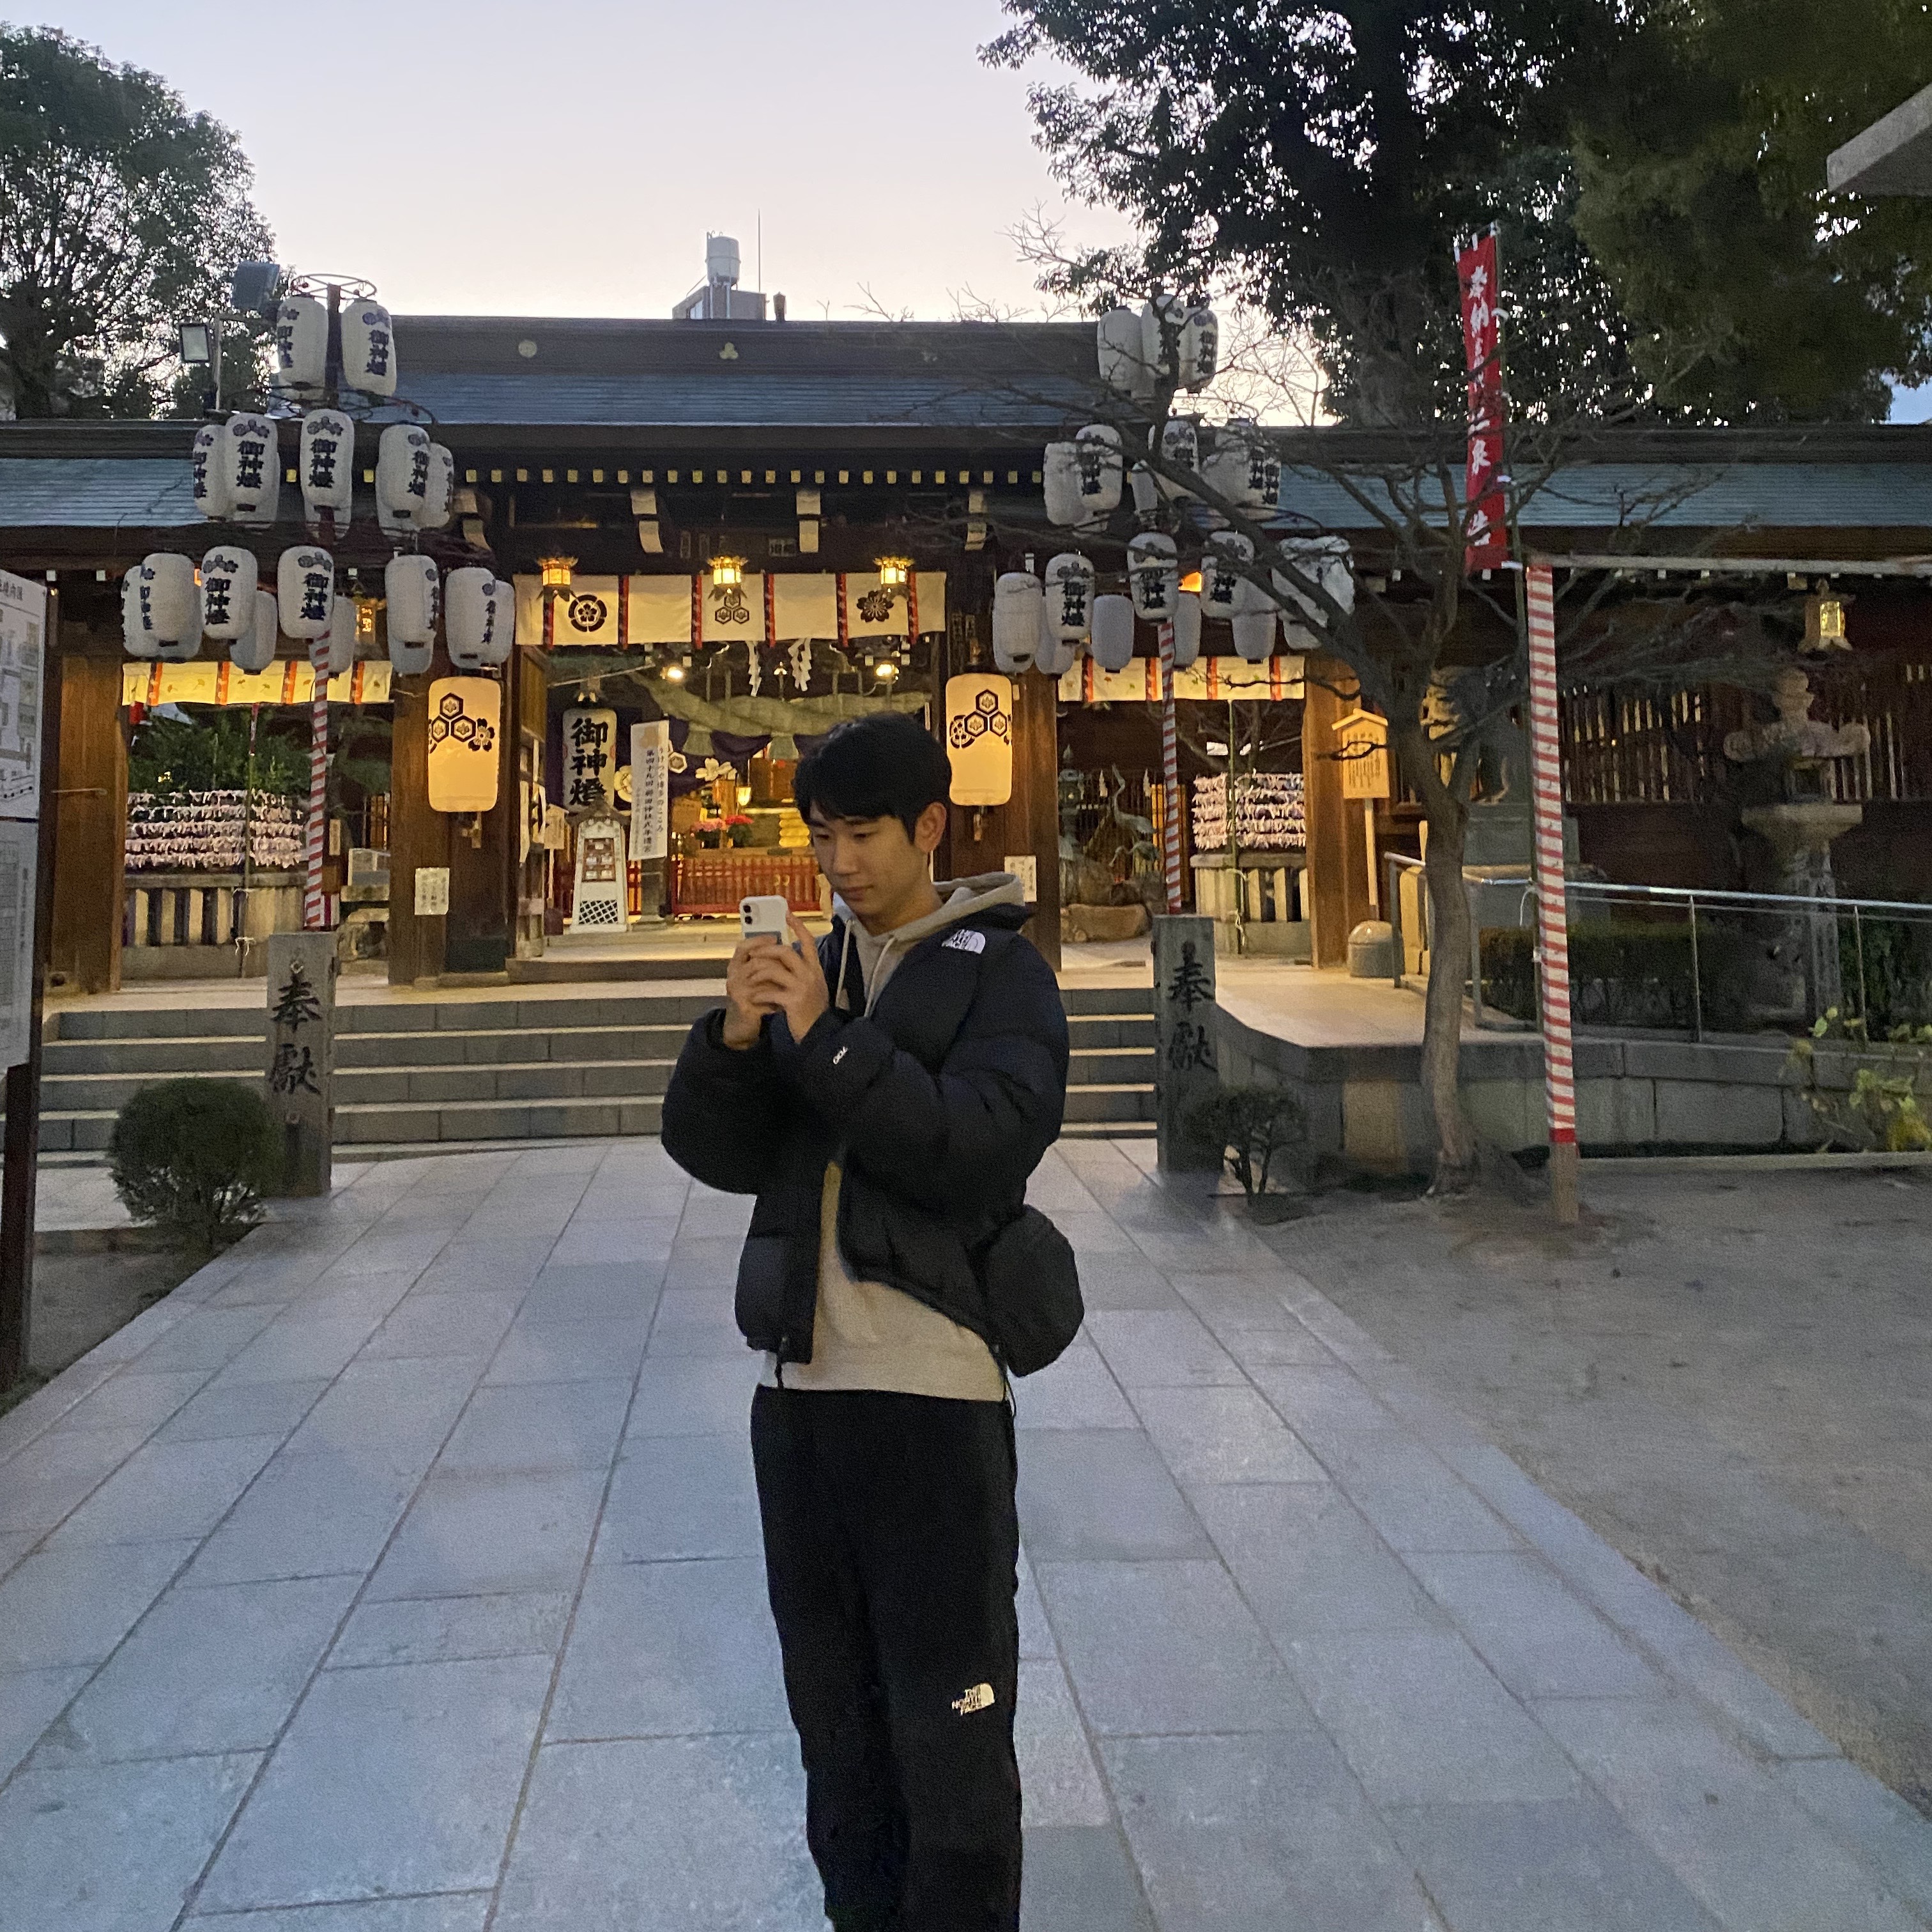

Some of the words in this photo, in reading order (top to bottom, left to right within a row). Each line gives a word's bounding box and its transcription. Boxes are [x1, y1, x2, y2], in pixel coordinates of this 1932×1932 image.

[236, 440, 266, 489] 御神燈
[308, 438, 339, 488] 御神燈
[205, 577, 231, 625] 御神燈
[300, 572, 329, 622] 御神燈
[569, 717, 609, 806] 御神燈
